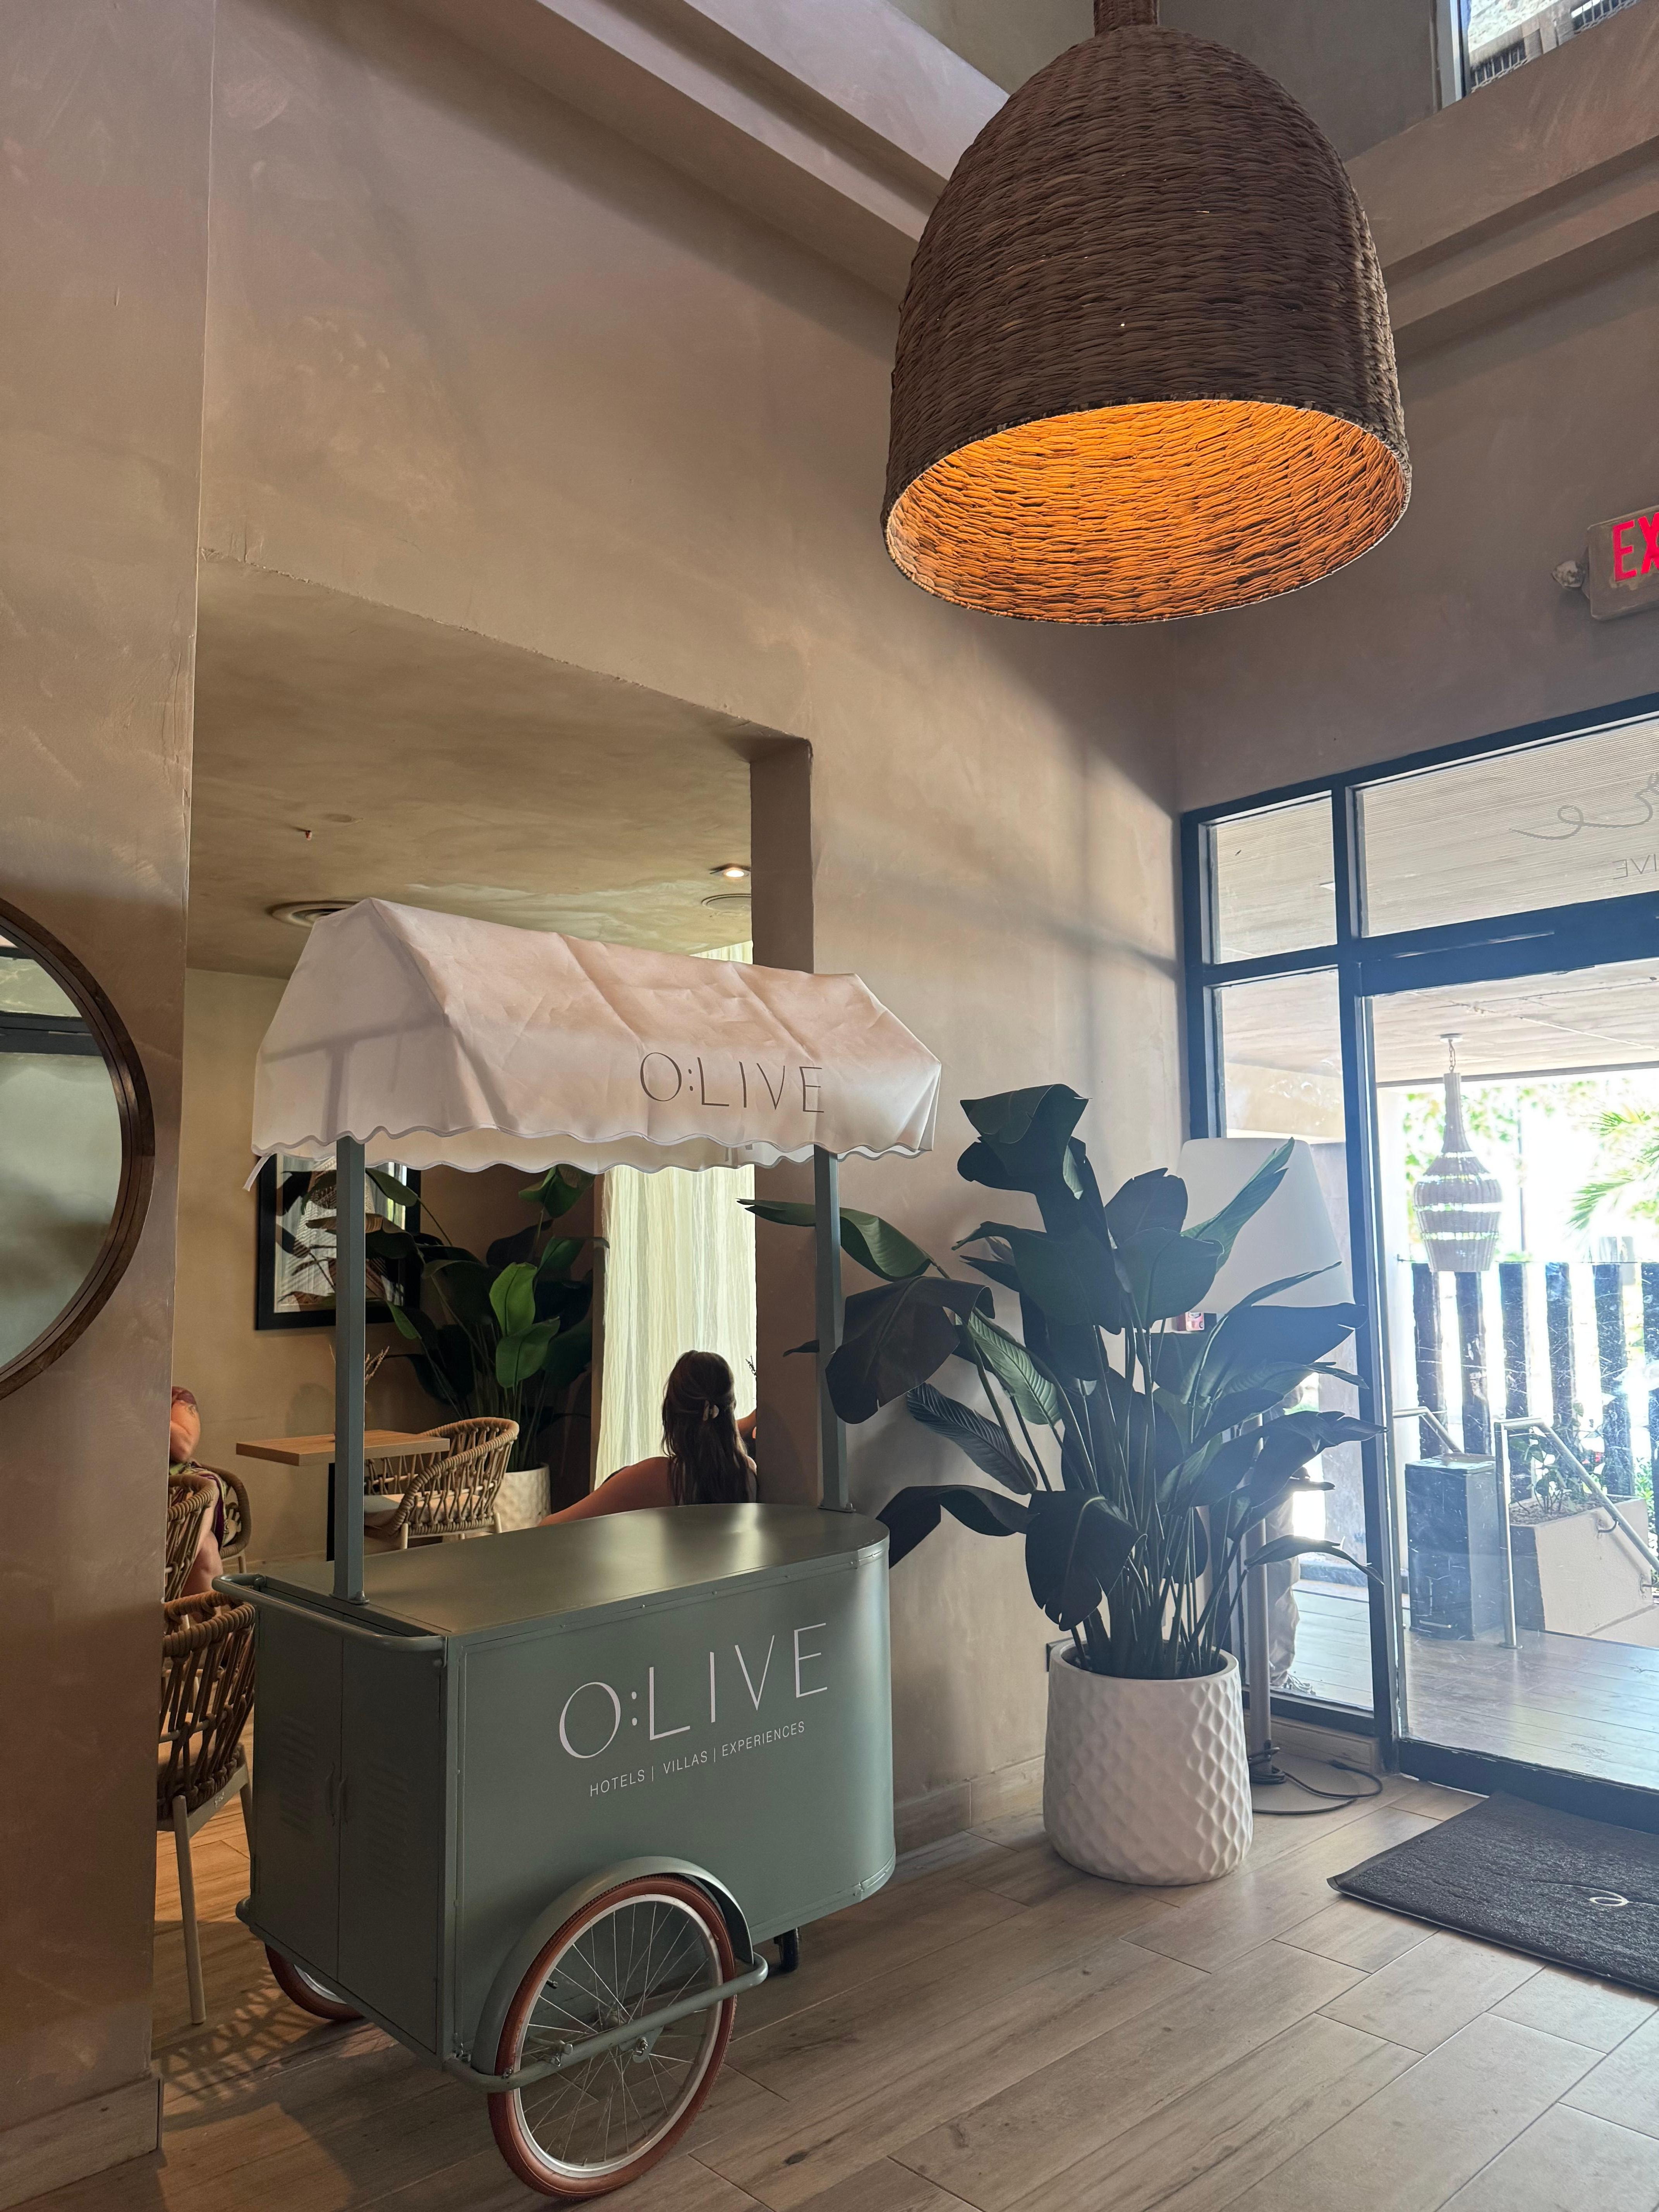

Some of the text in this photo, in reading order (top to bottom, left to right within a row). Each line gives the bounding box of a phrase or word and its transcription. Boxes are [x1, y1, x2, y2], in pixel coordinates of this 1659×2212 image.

[640, 1052, 824, 1113] O:LIVE
[559, 1623, 828, 1759] O:LIVE
[590, 1769, 644, 1797] HOTELS
[663, 1751, 708, 1774] VILLAS
[722, 1721, 805, 1756] EXPERIENCES
